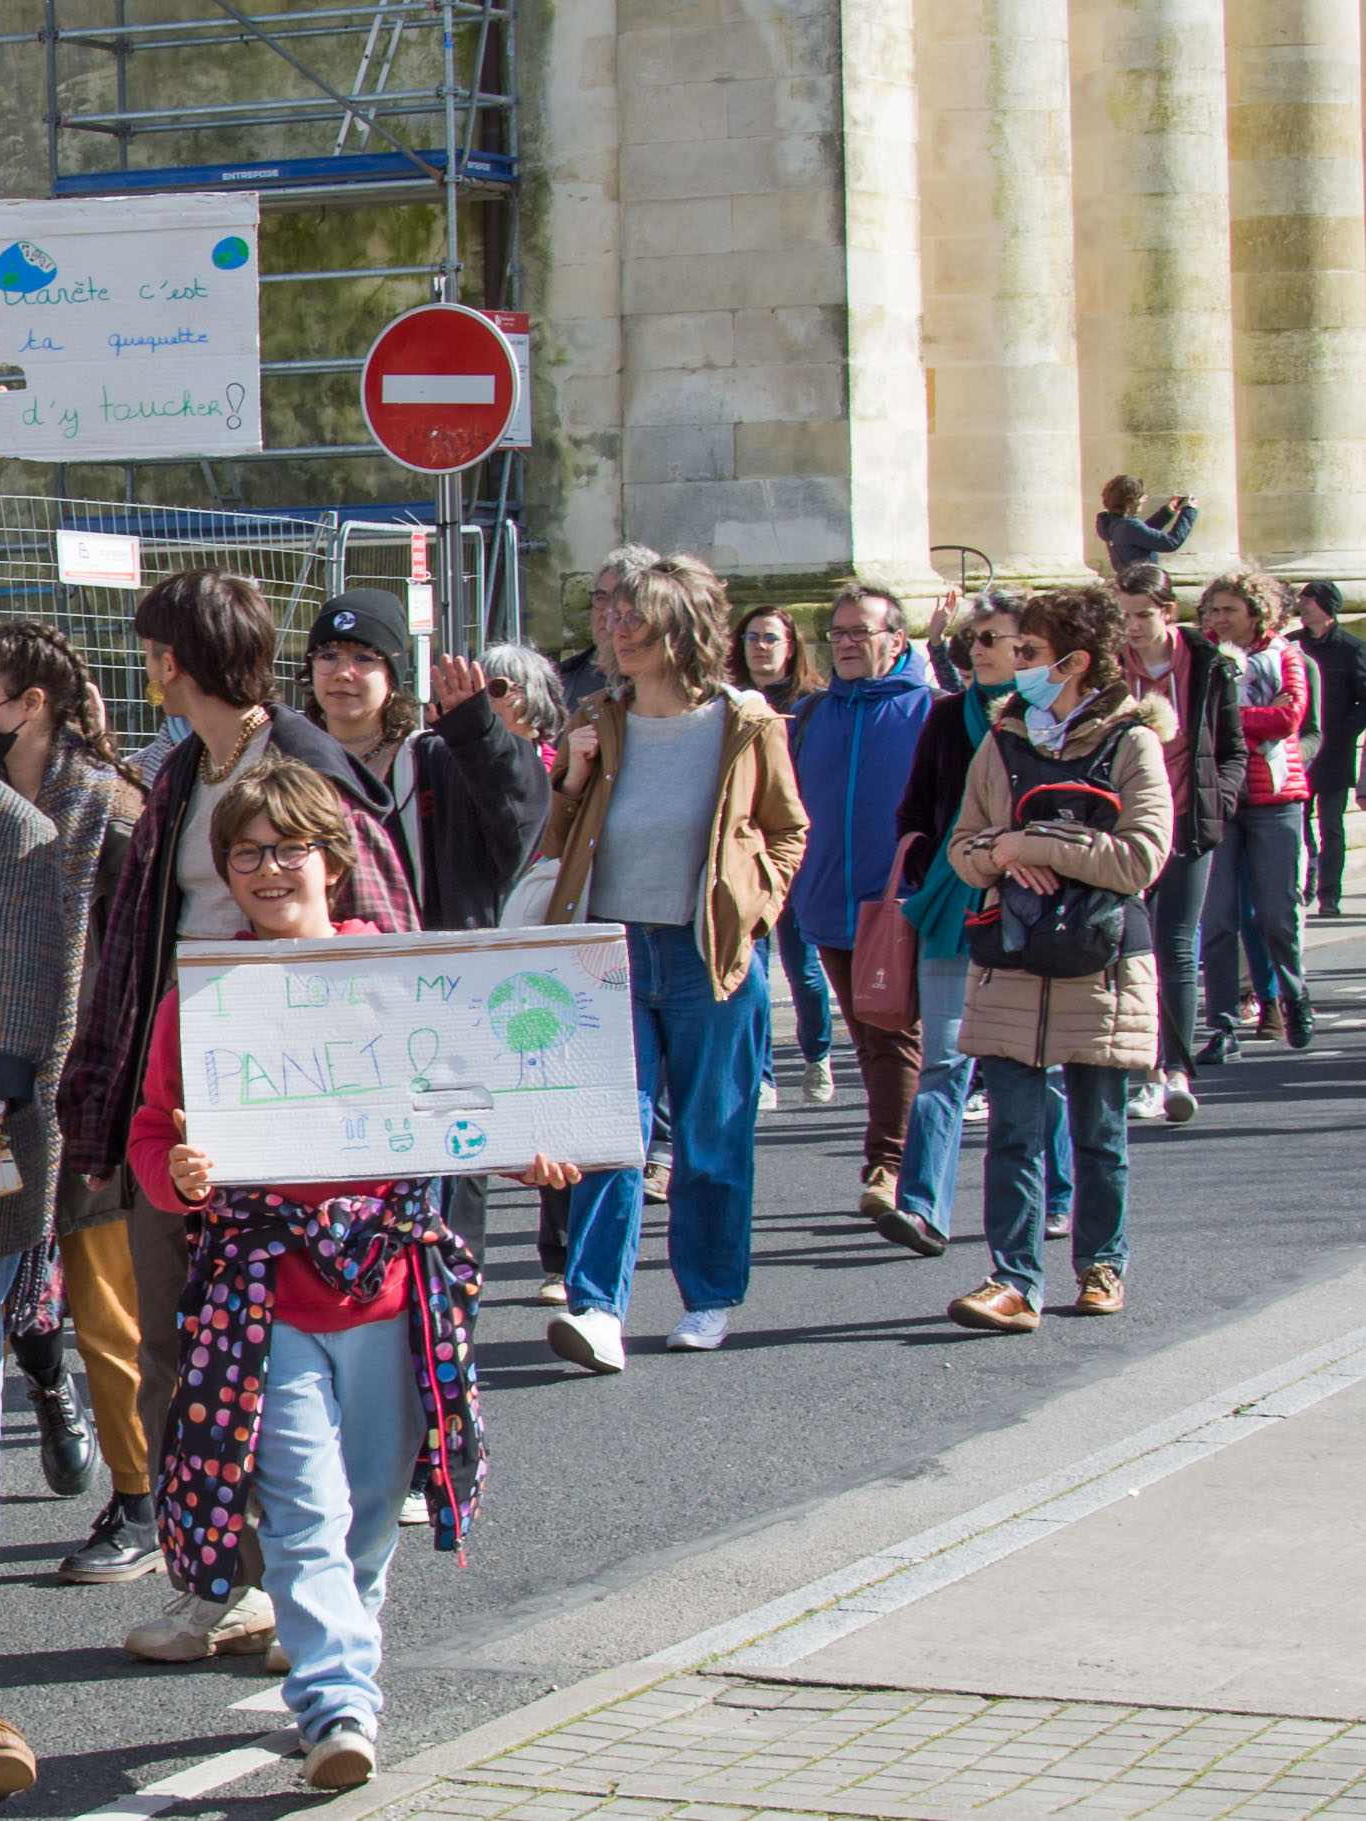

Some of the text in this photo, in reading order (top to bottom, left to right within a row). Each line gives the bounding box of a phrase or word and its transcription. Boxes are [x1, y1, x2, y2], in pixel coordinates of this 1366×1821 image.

[139, 276, 209, 301] c'est
[18, 328, 64, 352] ta
[107, 326, 209, 357] quequette
[21, 396, 82, 439] d'y
[205, 974, 462, 1018] I LOVE MY
